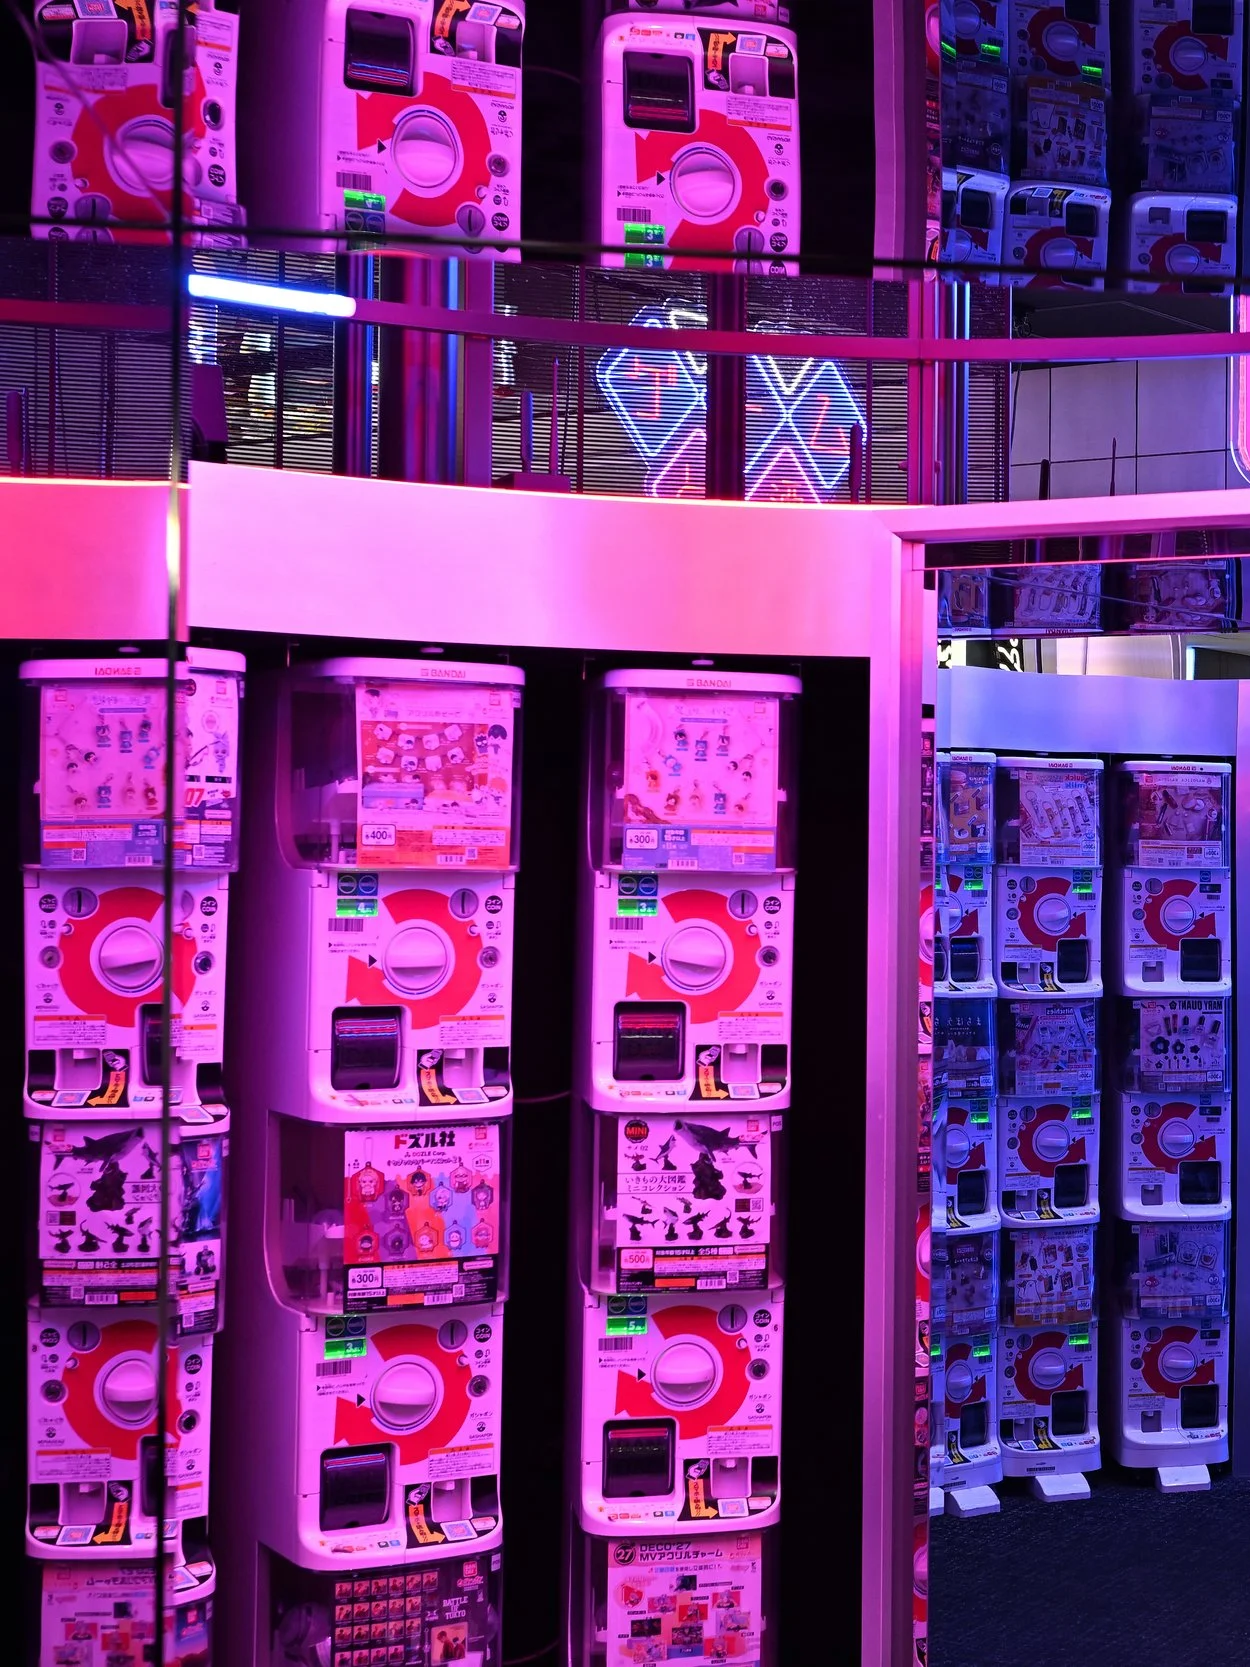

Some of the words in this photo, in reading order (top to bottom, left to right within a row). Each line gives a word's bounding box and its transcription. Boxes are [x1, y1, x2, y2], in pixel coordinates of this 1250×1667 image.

[430, 668, 467, 679] BANDAI
[696, 679, 732, 689] BANDAI
[185, 787, 205, 808] 07
[625, 1126, 648, 1137] MINI
[394, 1130, 457, 1150] ドズル社
[639, 1144, 649, 1152] 02
[624, 1174, 687, 1185] いきもの大図鑑
[626, 1184, 687, 1193] ミニコレクション
[616, 1549, 634, 1561] 27
[639, 1549, 724, 1562] MVアクリルチャーム
[442, 1595, 469, 1608] BATTLE
[444, 1609, 467, 1621] TOKYO
